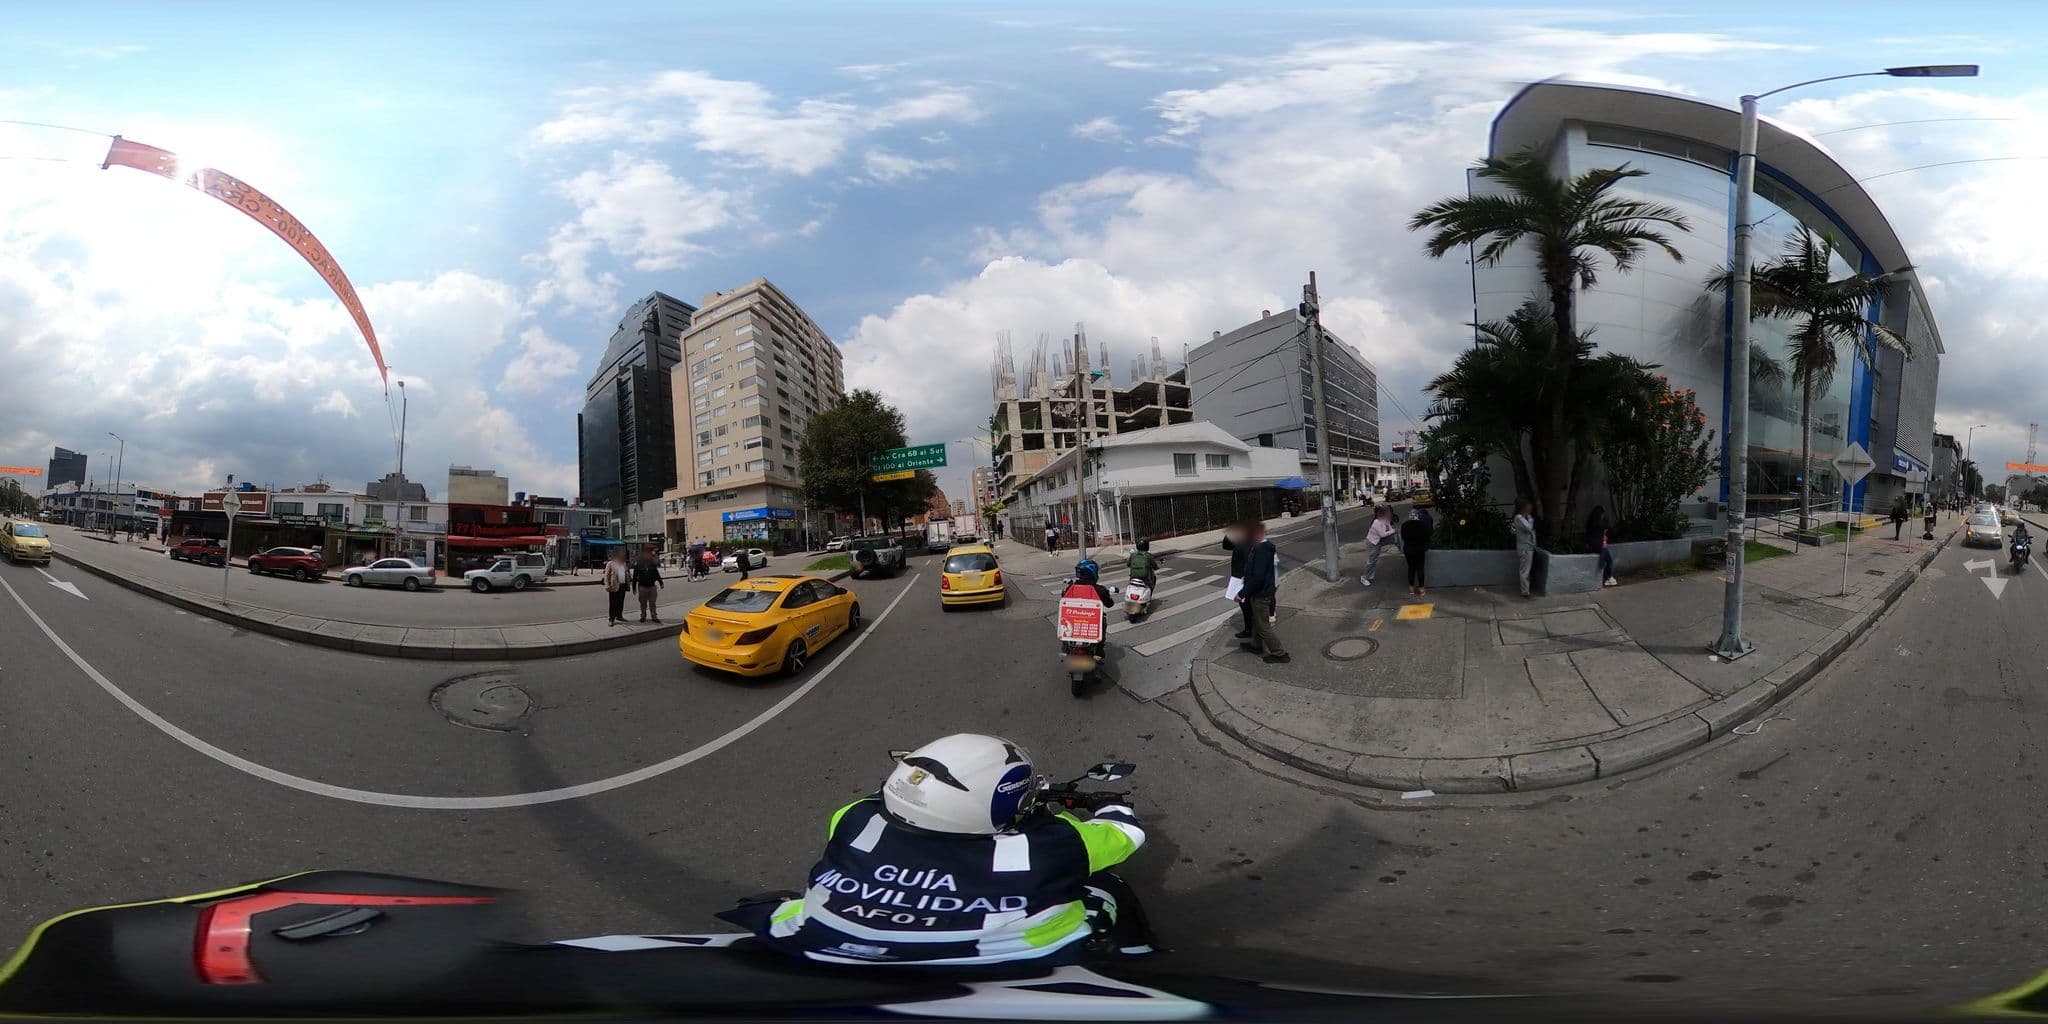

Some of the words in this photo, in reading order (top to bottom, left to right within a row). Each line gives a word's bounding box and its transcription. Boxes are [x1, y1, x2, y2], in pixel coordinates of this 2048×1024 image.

[929, 447, 943, 455] Sur
[907, 459, 934, 467] Oriente
[874, 864, 957, 892] GUÍA
[815, 868, 1029, 913] MOVILIDAD
[842, 904, 938, 927] AF01
